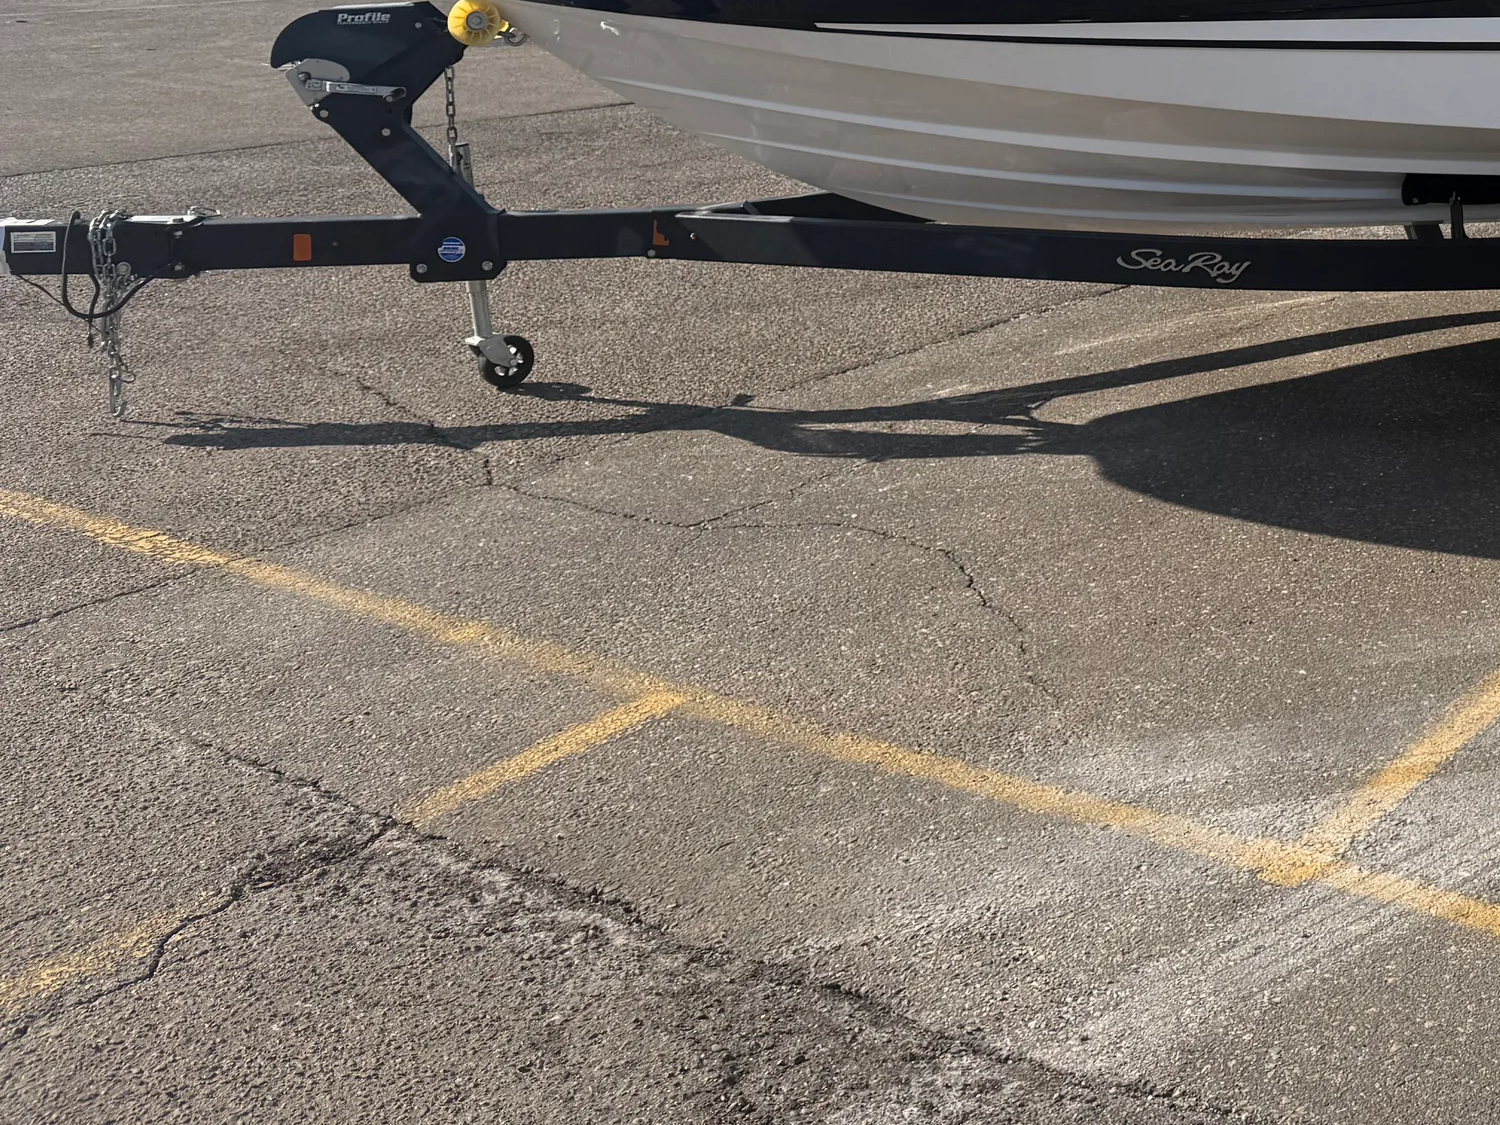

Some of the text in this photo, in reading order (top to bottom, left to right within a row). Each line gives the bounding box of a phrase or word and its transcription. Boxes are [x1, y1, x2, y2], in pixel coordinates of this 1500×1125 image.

[337, 12, 391, 22] Profile
[1116, 248, 1251, 283] Sea Ray
